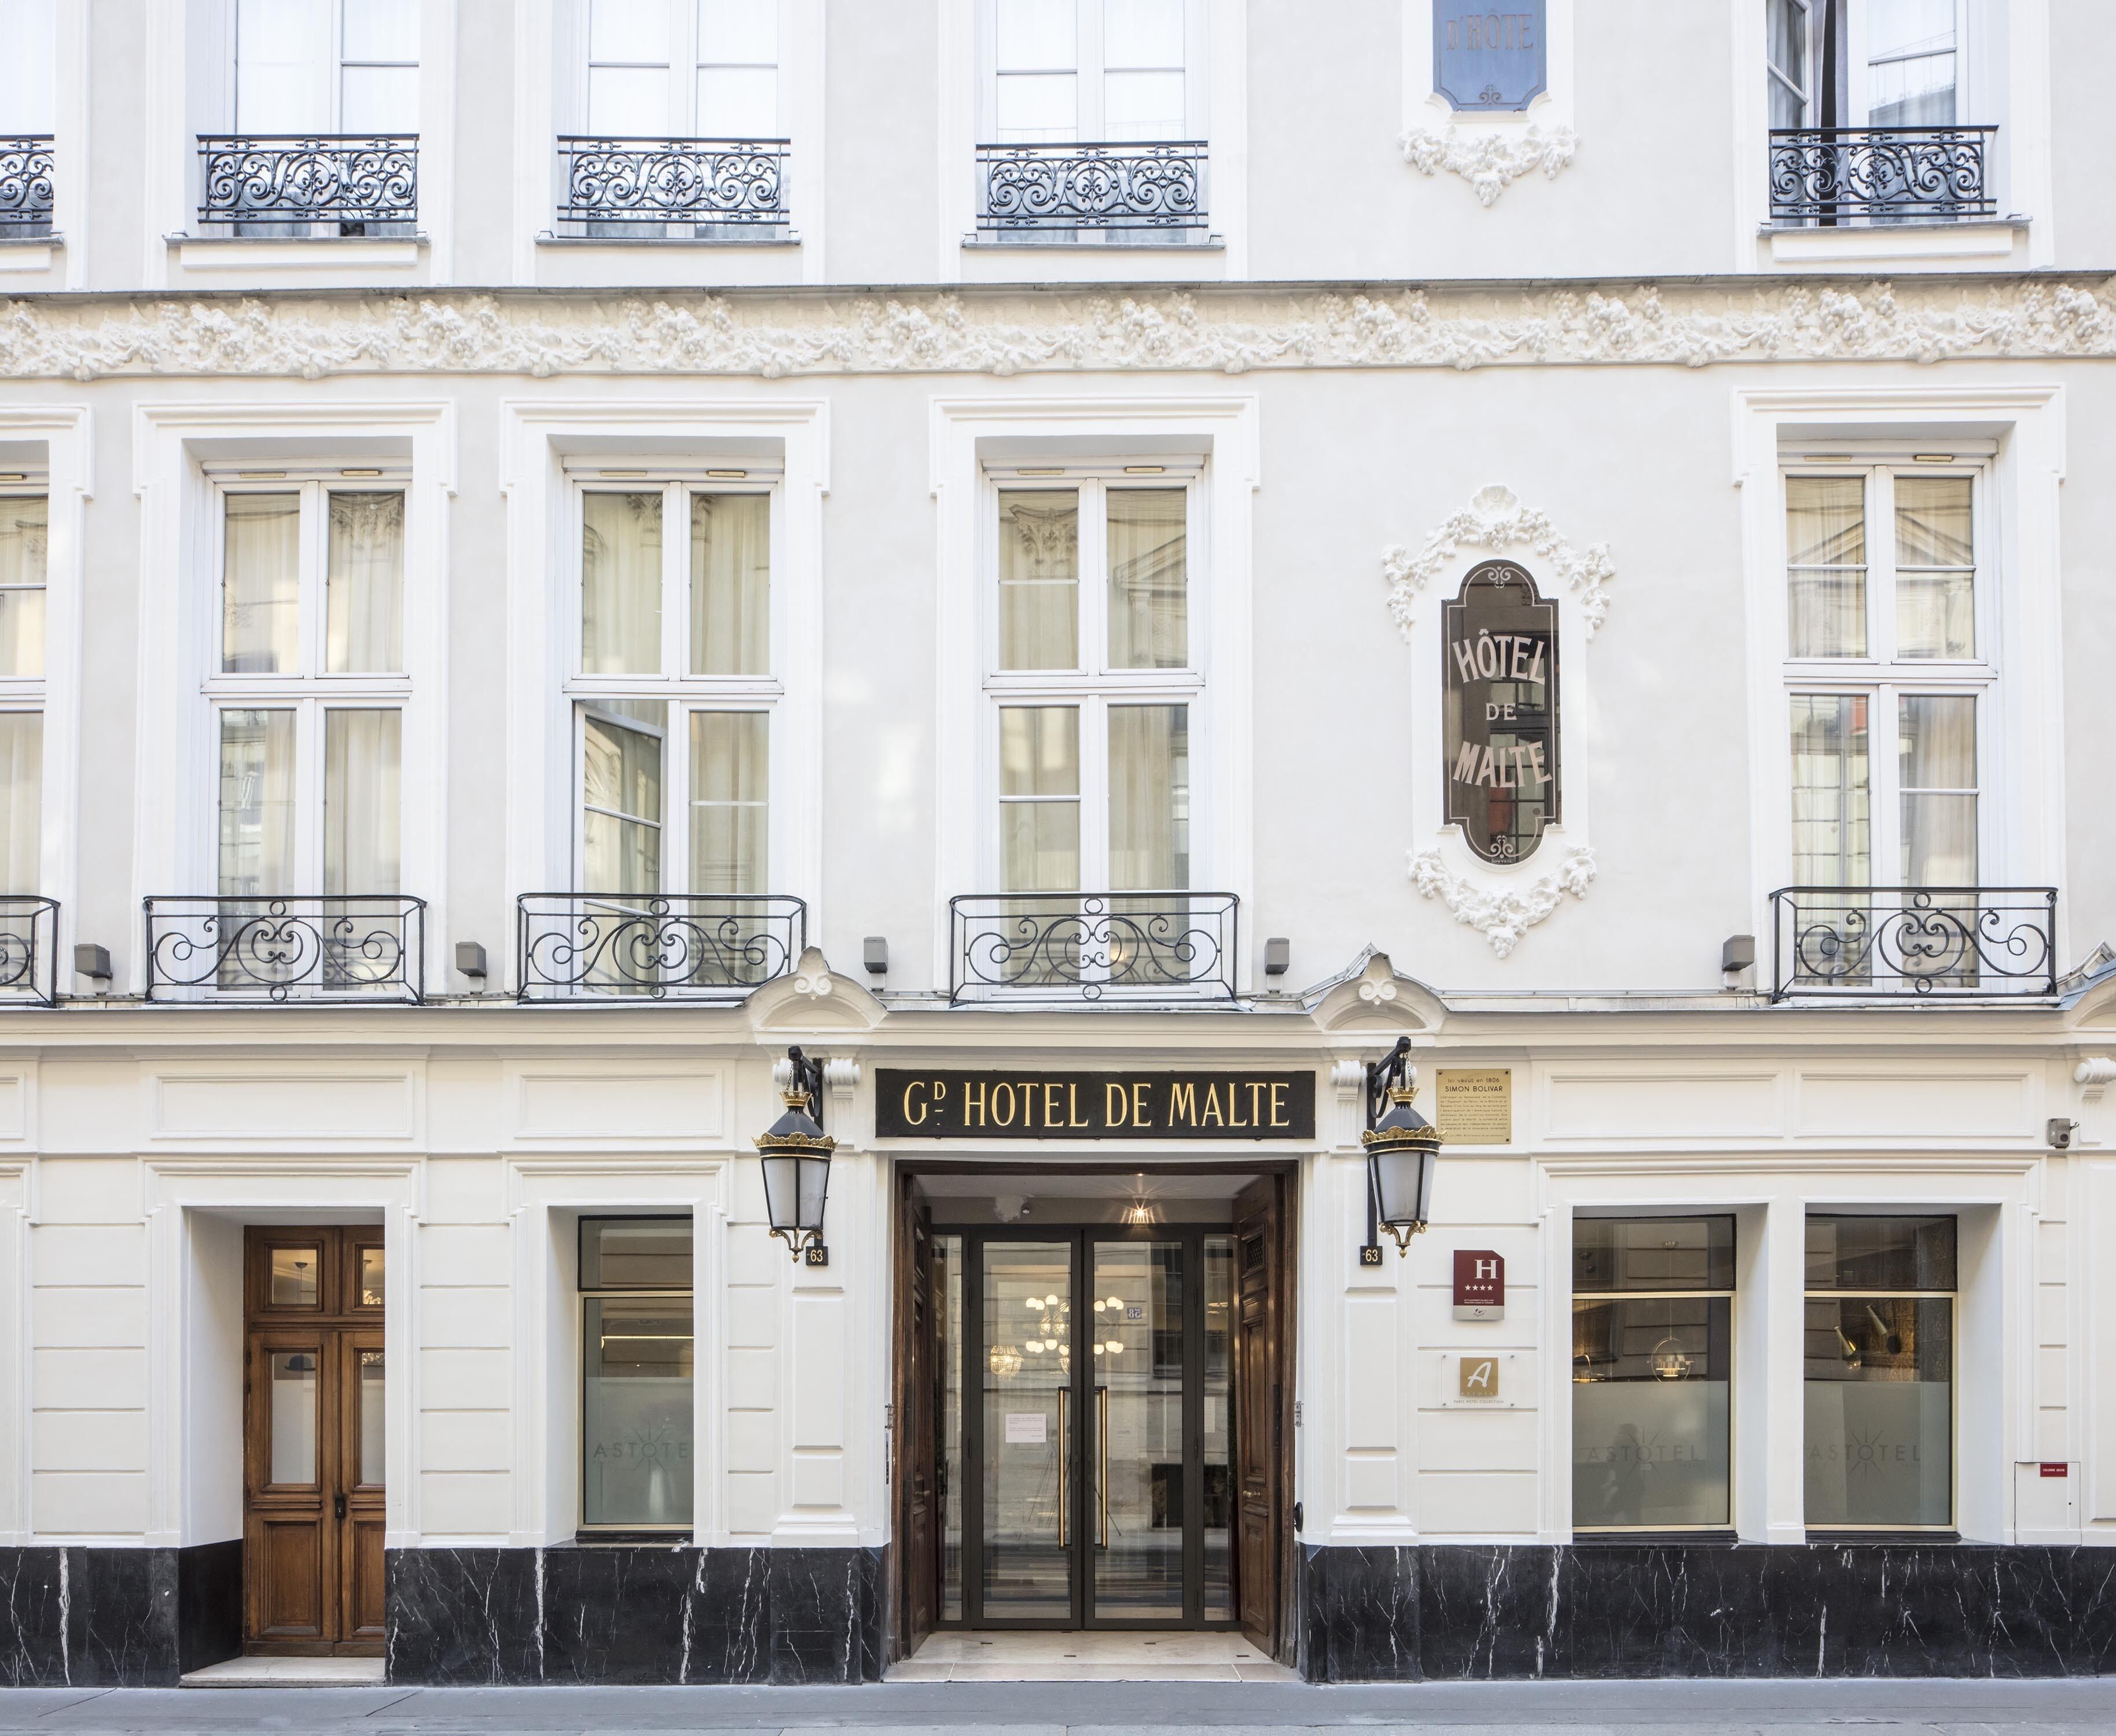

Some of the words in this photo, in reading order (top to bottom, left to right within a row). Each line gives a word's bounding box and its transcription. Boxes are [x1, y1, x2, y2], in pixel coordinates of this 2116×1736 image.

[1446, 8, 1534, 51] D'HÔTE
[1452, 628, 1546, 685] HÔTEL
[1486, 703, 1517, 720] DE
[1452, 740, 1552, 788] MALTE
[964, 1082, 1089, 1127] HOTEL
[1105, 1083, 1152, 1127] DE
[1168, 1082, 1290, 1127] MALTE
[810, 1249, 823, 1262] 63
[1365, 1249, 1378, 1262] 63
[1474, 1259, 1498, 1279] H
[593, 1442, 688, 1458] ASTOTE
[1587, 1445, 1699, 1462] ASTOTEL
[1809, 1444, 1921, 1461] ASTOTEL
